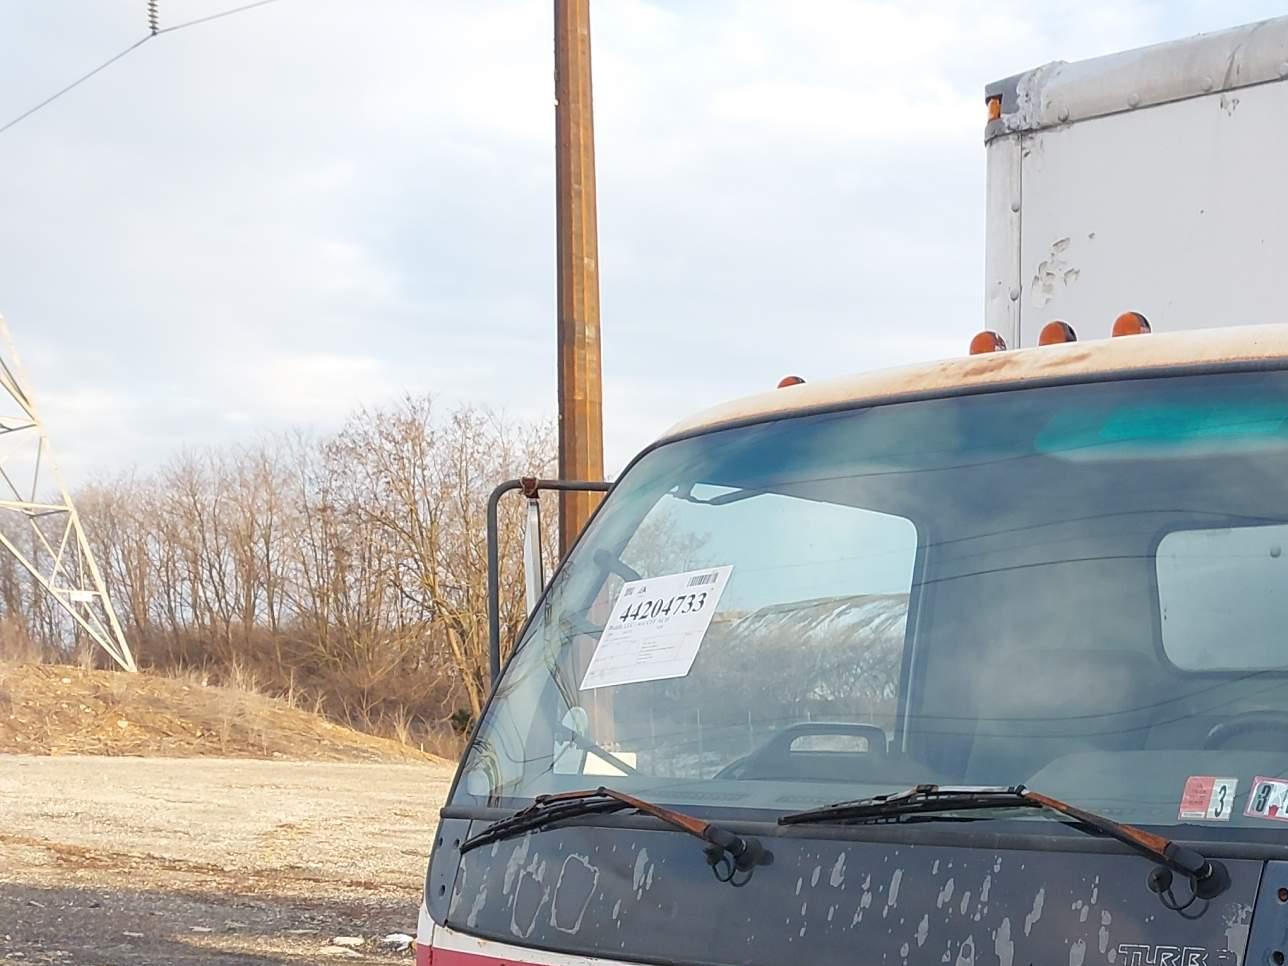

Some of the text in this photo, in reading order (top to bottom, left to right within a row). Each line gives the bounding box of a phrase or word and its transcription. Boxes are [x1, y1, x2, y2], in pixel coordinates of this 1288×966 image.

[619, 592, 708, 623] 44204733
[1214, 784, 1227, 818] 3
[1255, 784, 1272, 812] 3
